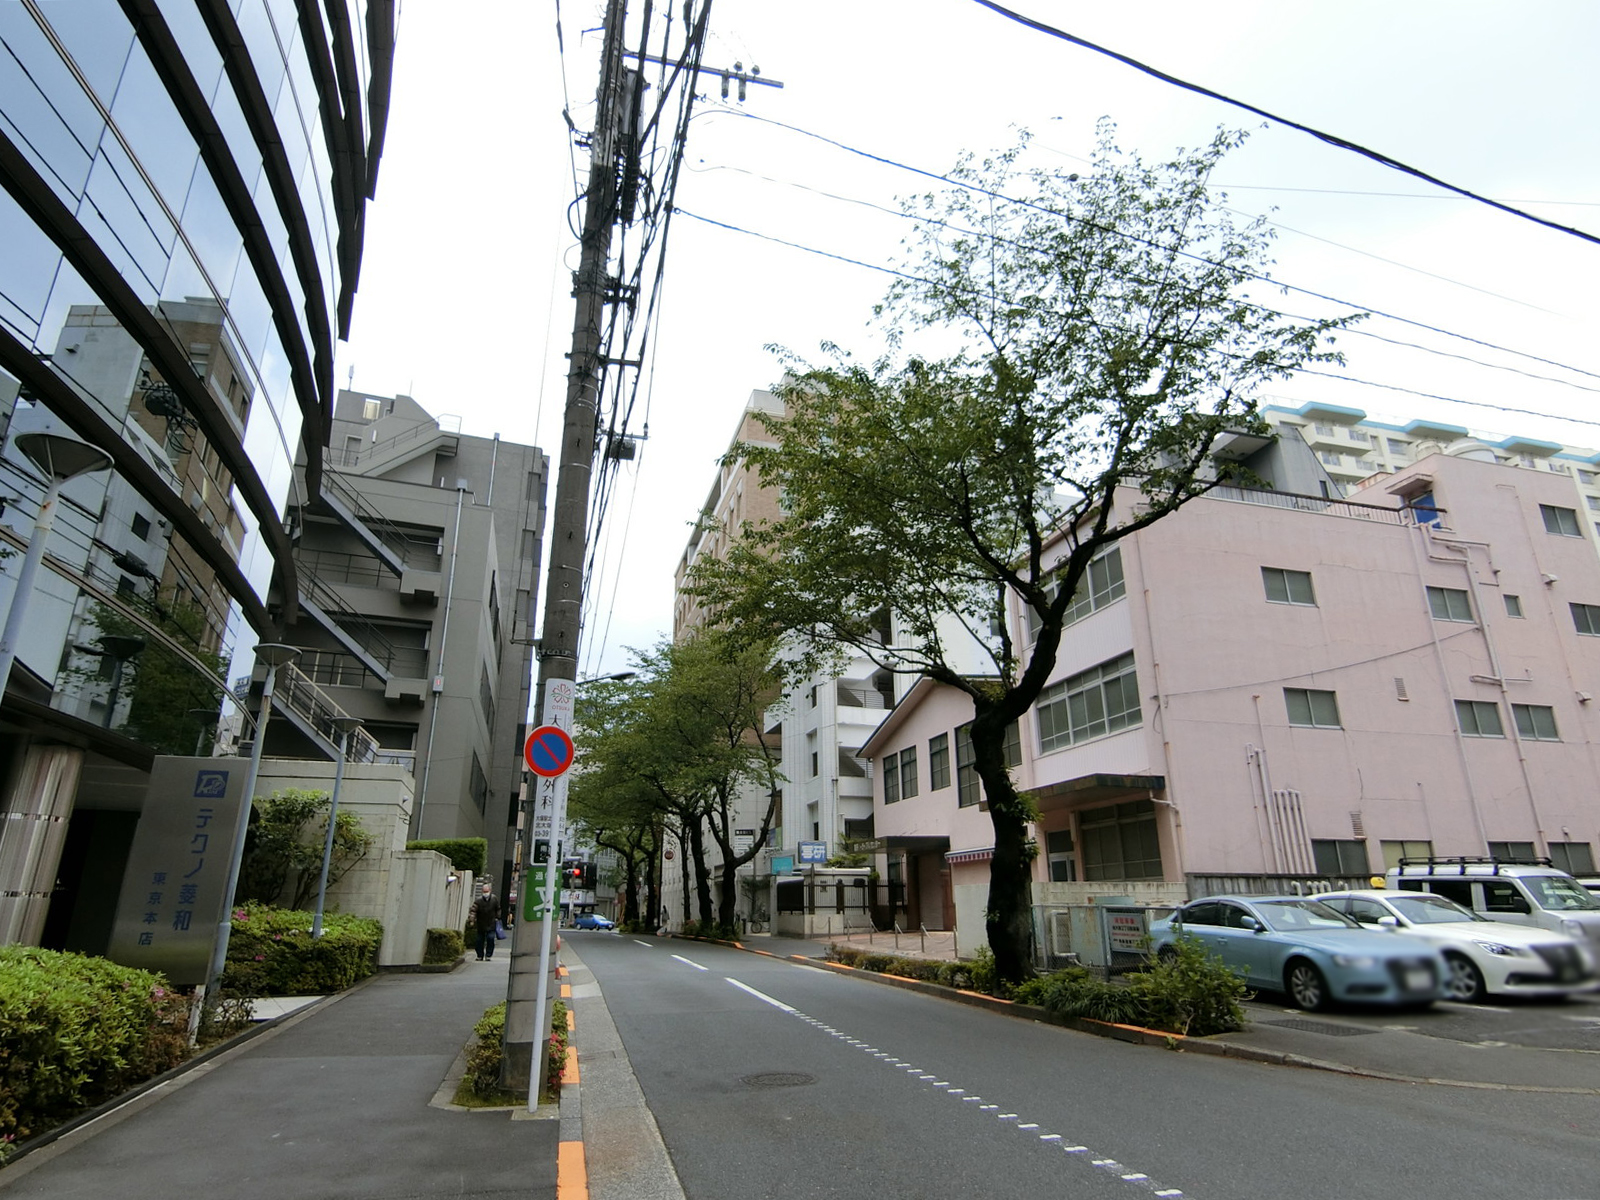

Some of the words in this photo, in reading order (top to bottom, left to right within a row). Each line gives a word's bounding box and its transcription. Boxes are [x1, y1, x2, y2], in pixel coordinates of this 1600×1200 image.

[138, 872, 167, 945] 東京本店
[173, 809, 213, 931] テクノ菱和
